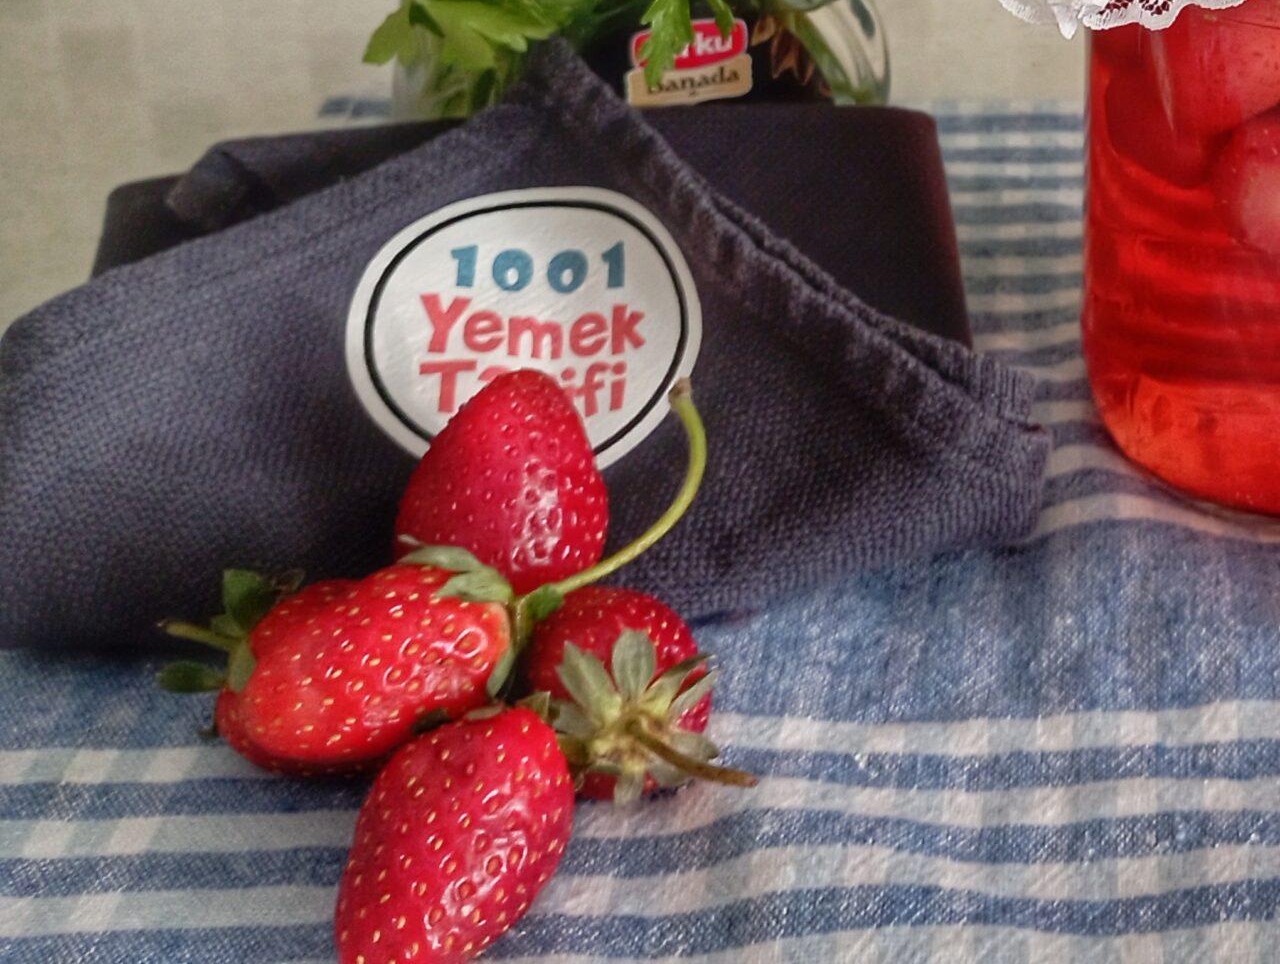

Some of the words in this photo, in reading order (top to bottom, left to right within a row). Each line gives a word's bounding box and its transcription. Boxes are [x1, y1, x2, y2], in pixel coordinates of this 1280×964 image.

[451, 241, 625, 293] 1001
[420, 293, 646, 359] Yemek
[419, 359, 628, 417] Tifi
